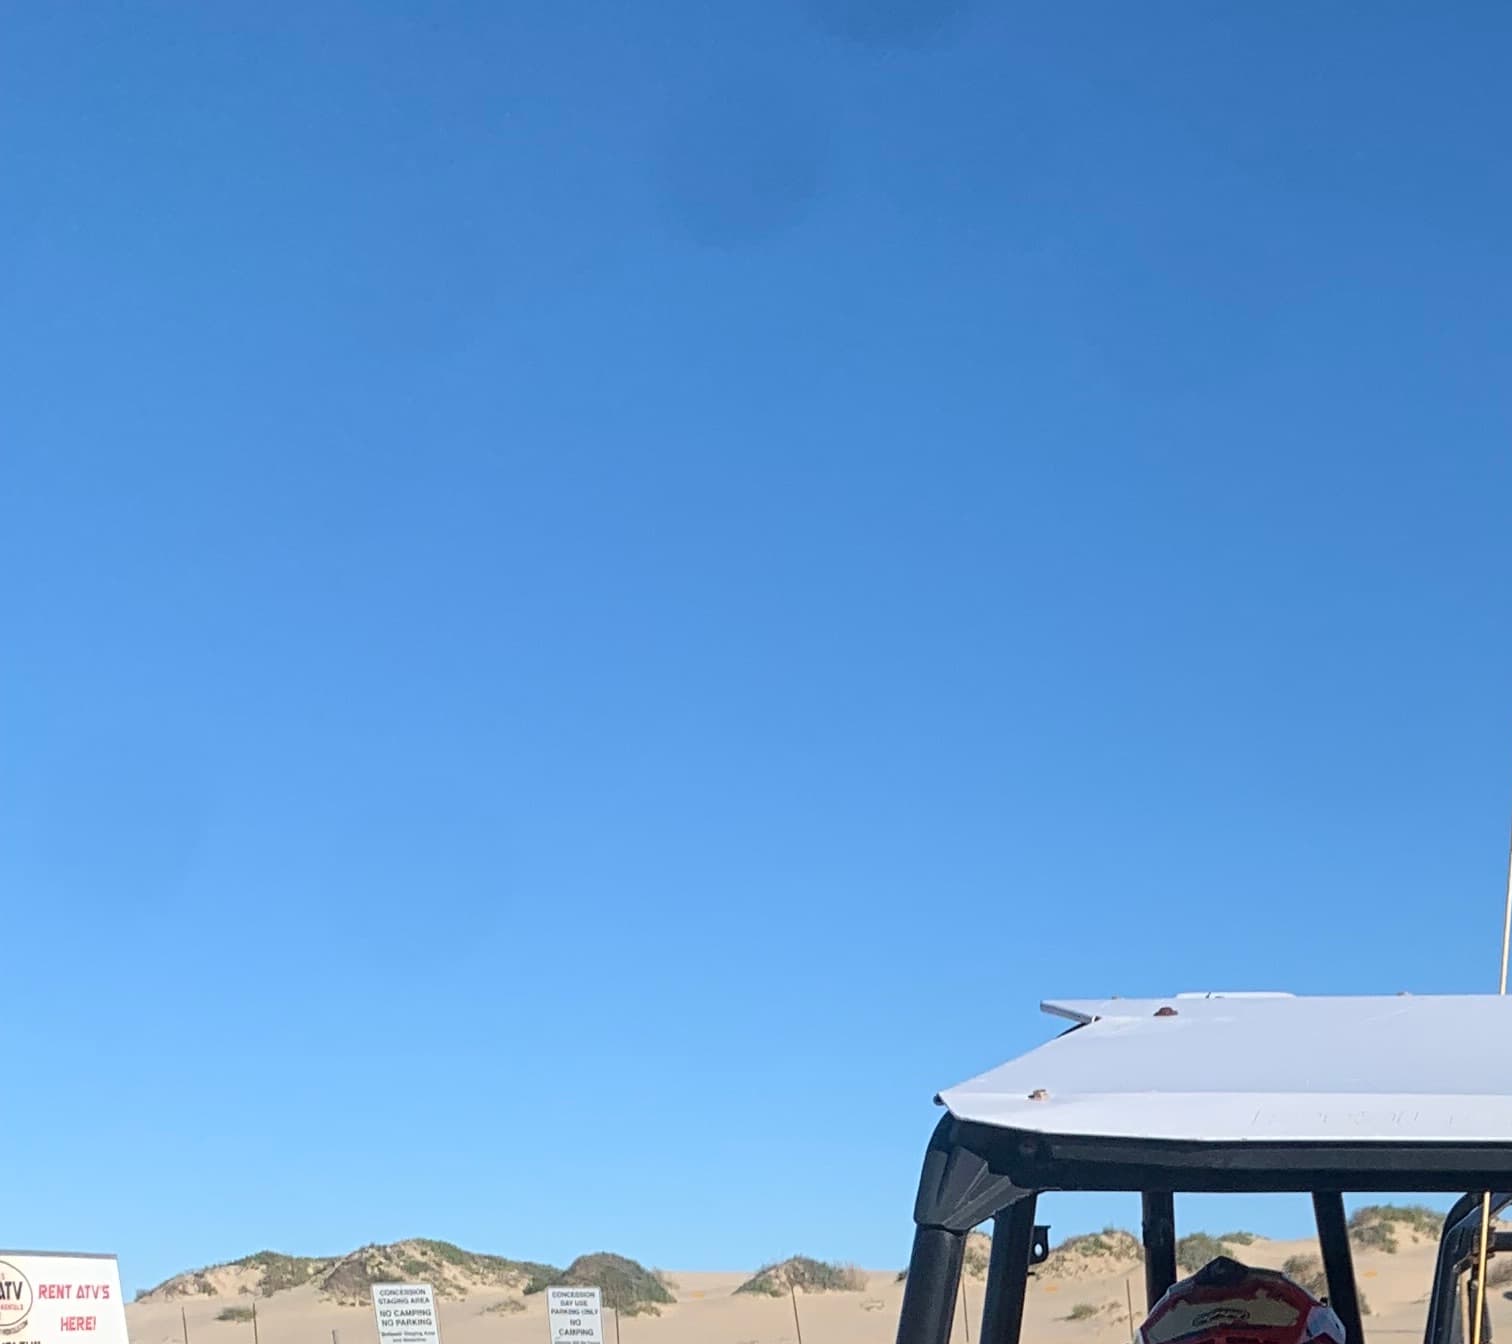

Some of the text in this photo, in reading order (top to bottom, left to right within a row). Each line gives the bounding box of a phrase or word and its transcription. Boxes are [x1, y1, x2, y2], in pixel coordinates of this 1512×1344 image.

[38, 1284, 72, 1299] RENT
[379, 1288, 426, 1296] CONCESSION
[379, 1308, 431, 1317] NO CAMPING
[60, 1316, 97, 1331] HERE!
[381, 1318, 432, 1327] NO PARKING
[558, 1328, 594, 1336] CAMPING
